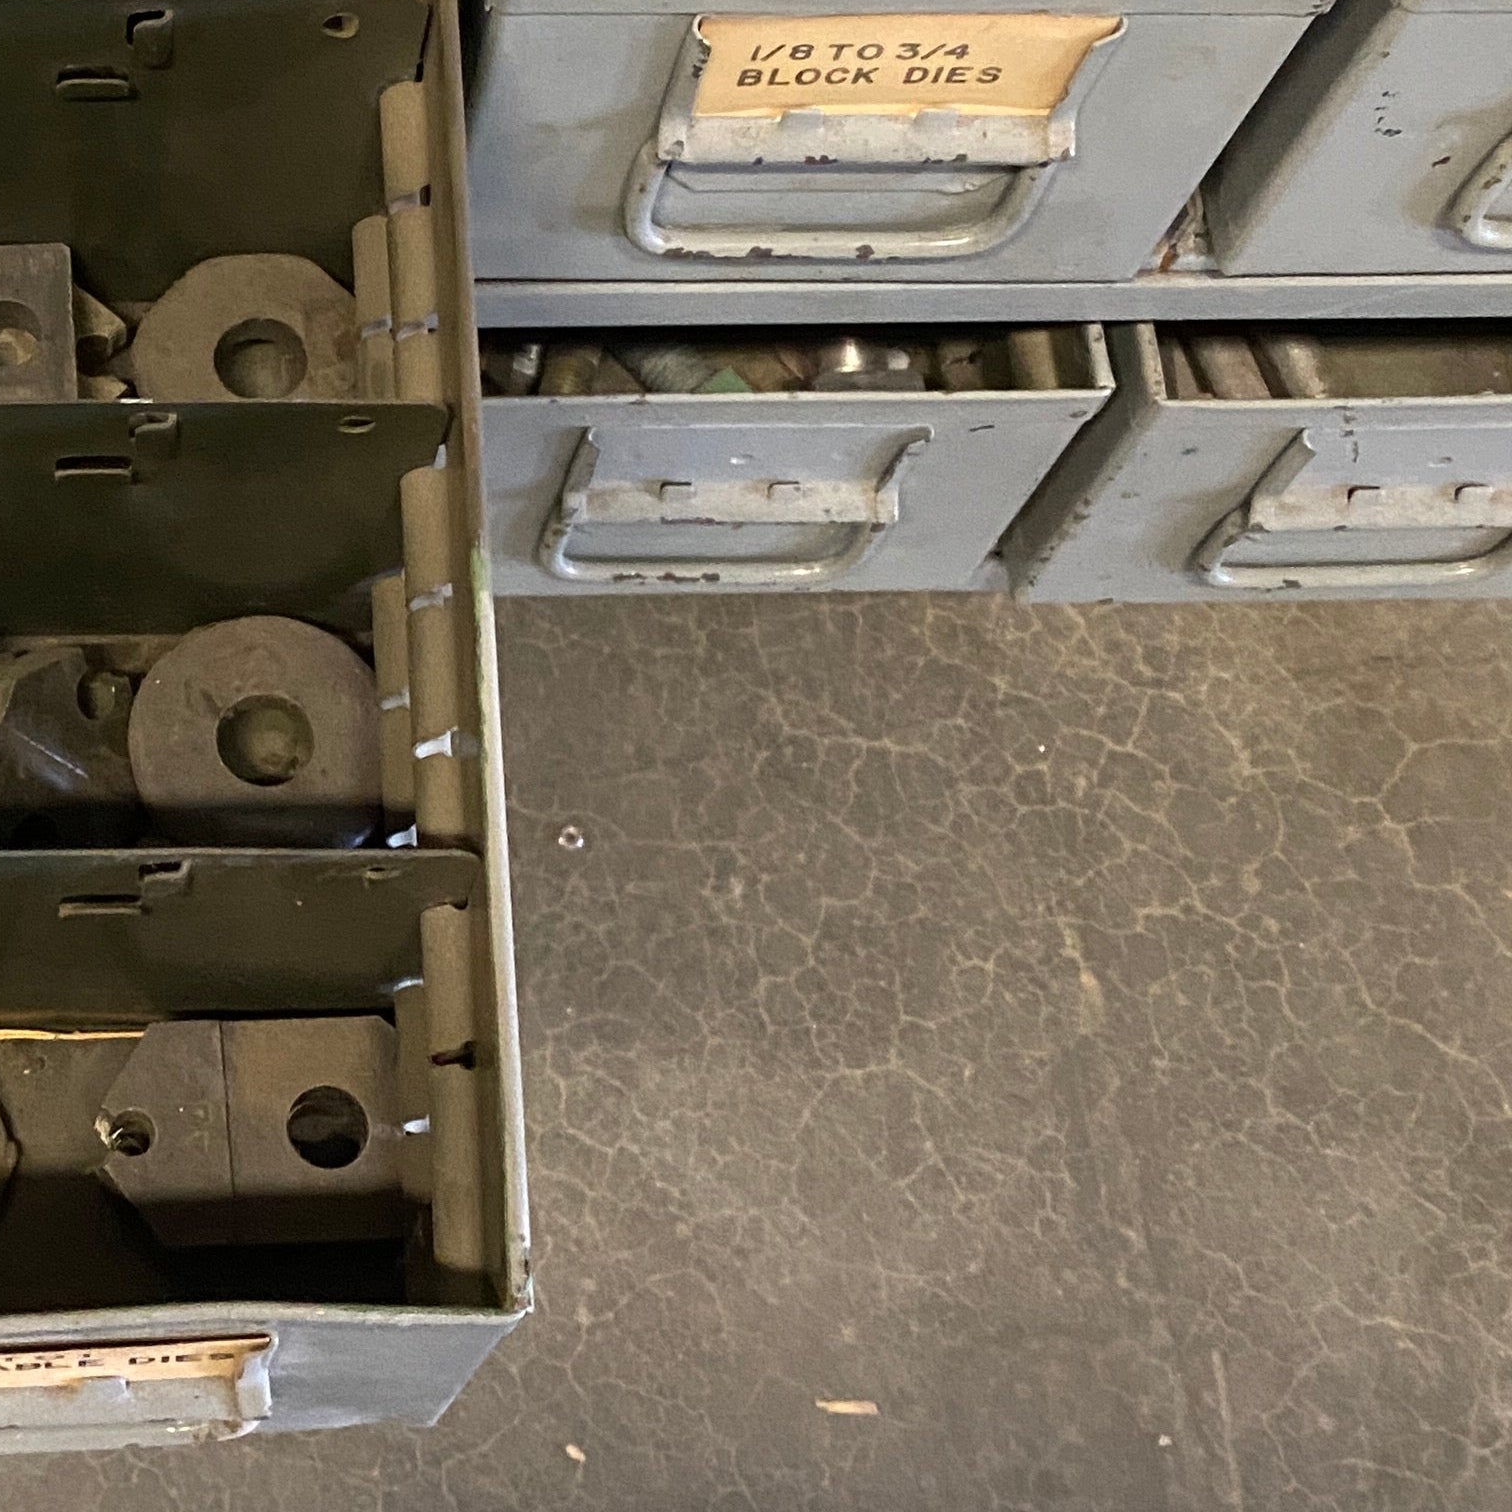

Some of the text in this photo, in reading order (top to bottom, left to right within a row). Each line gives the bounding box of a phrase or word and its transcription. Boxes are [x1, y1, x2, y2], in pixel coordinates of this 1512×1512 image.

[750, 42, 970, 62] 1/8 TO 3/4
[736, 65, 1004, 88] BLOCK DIES
